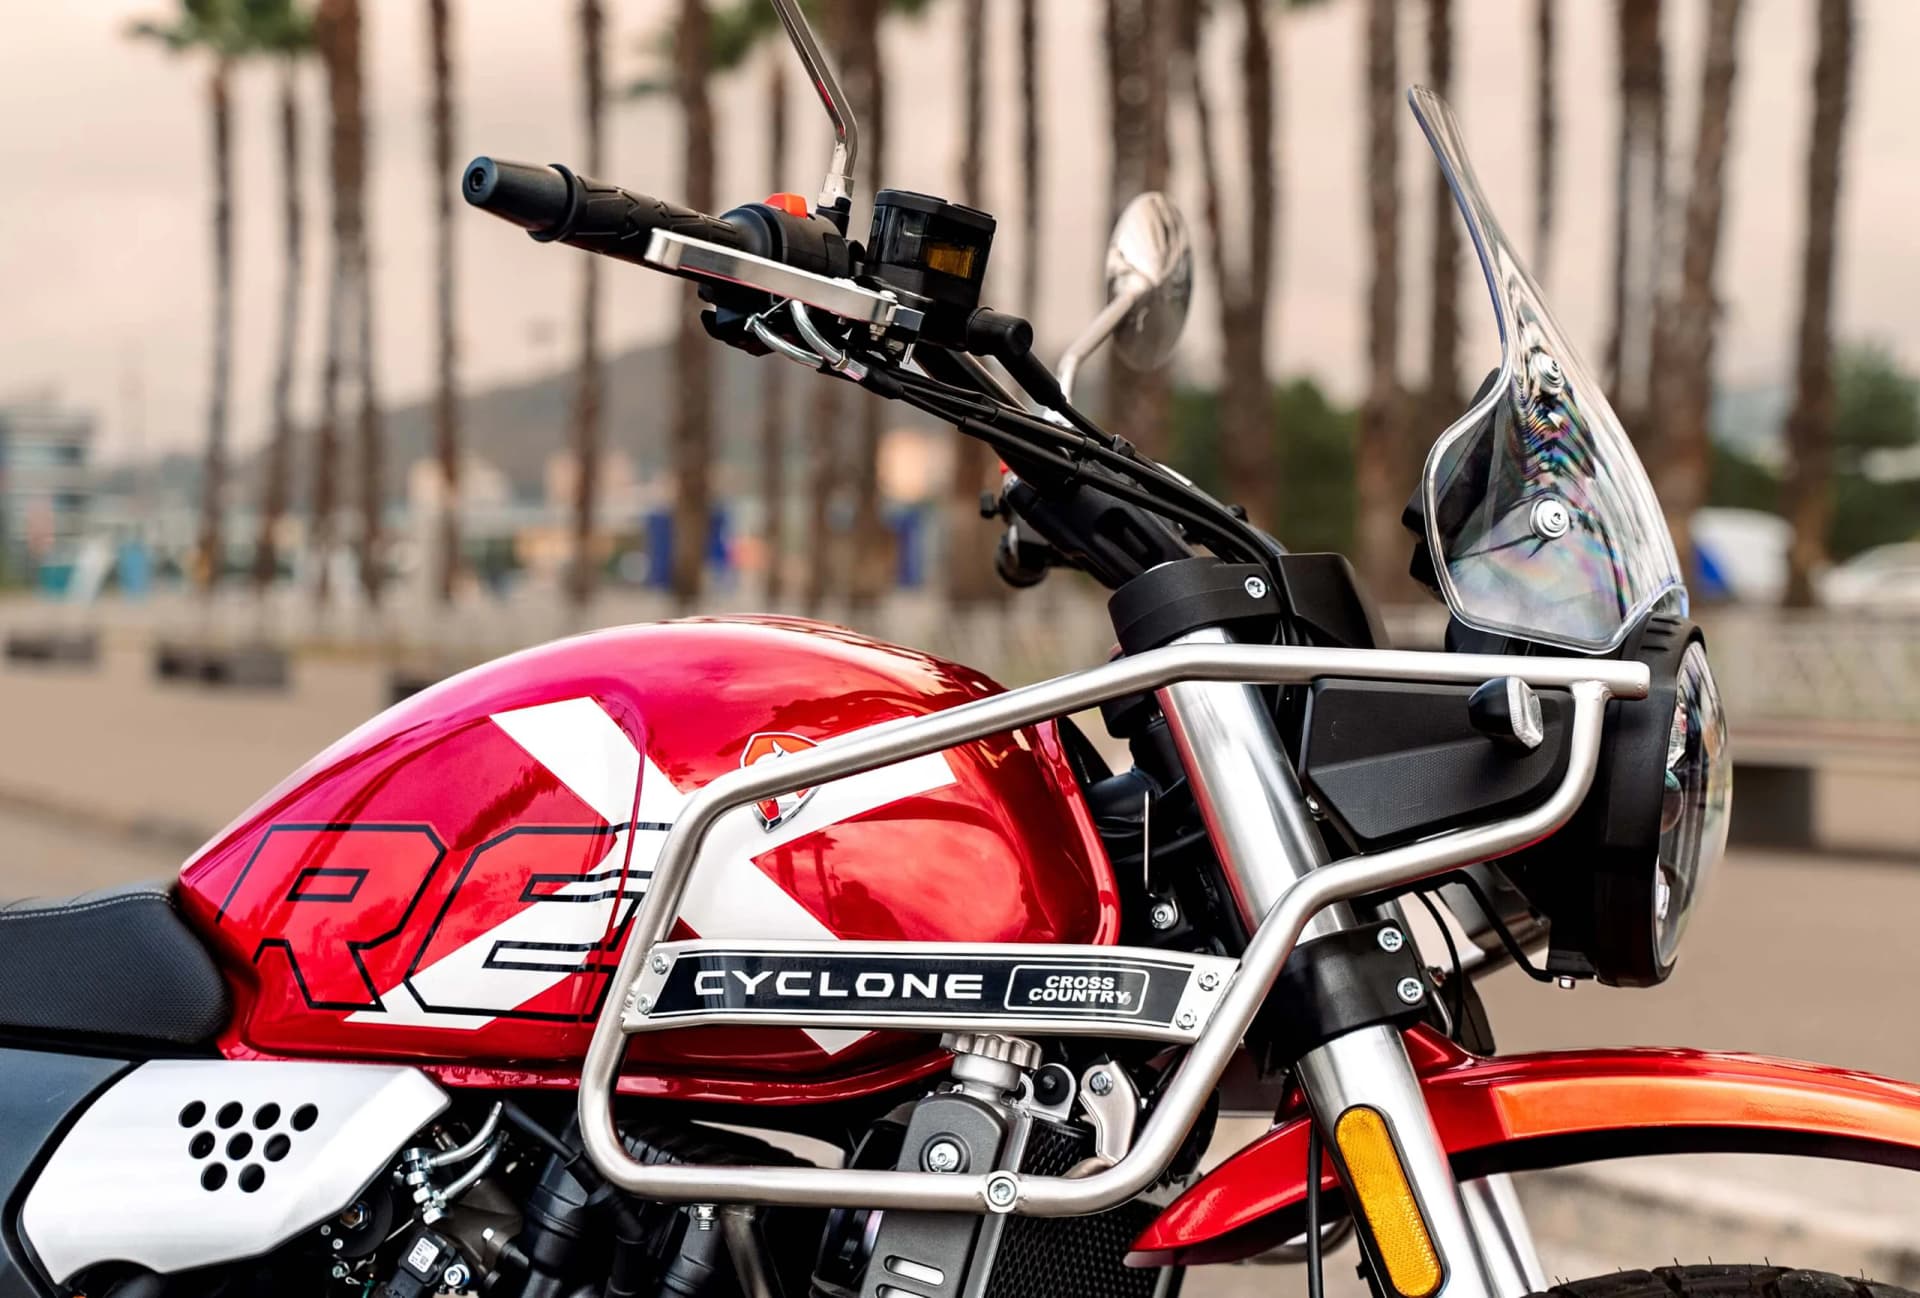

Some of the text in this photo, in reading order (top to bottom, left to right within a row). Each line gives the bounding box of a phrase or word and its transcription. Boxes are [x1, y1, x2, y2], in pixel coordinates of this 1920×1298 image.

[694, 970, 984, 999] CYCLONE
[1045, 975, 1115, 989] CROSS
[1028, 988, 1130, 1004] COUNTRY
